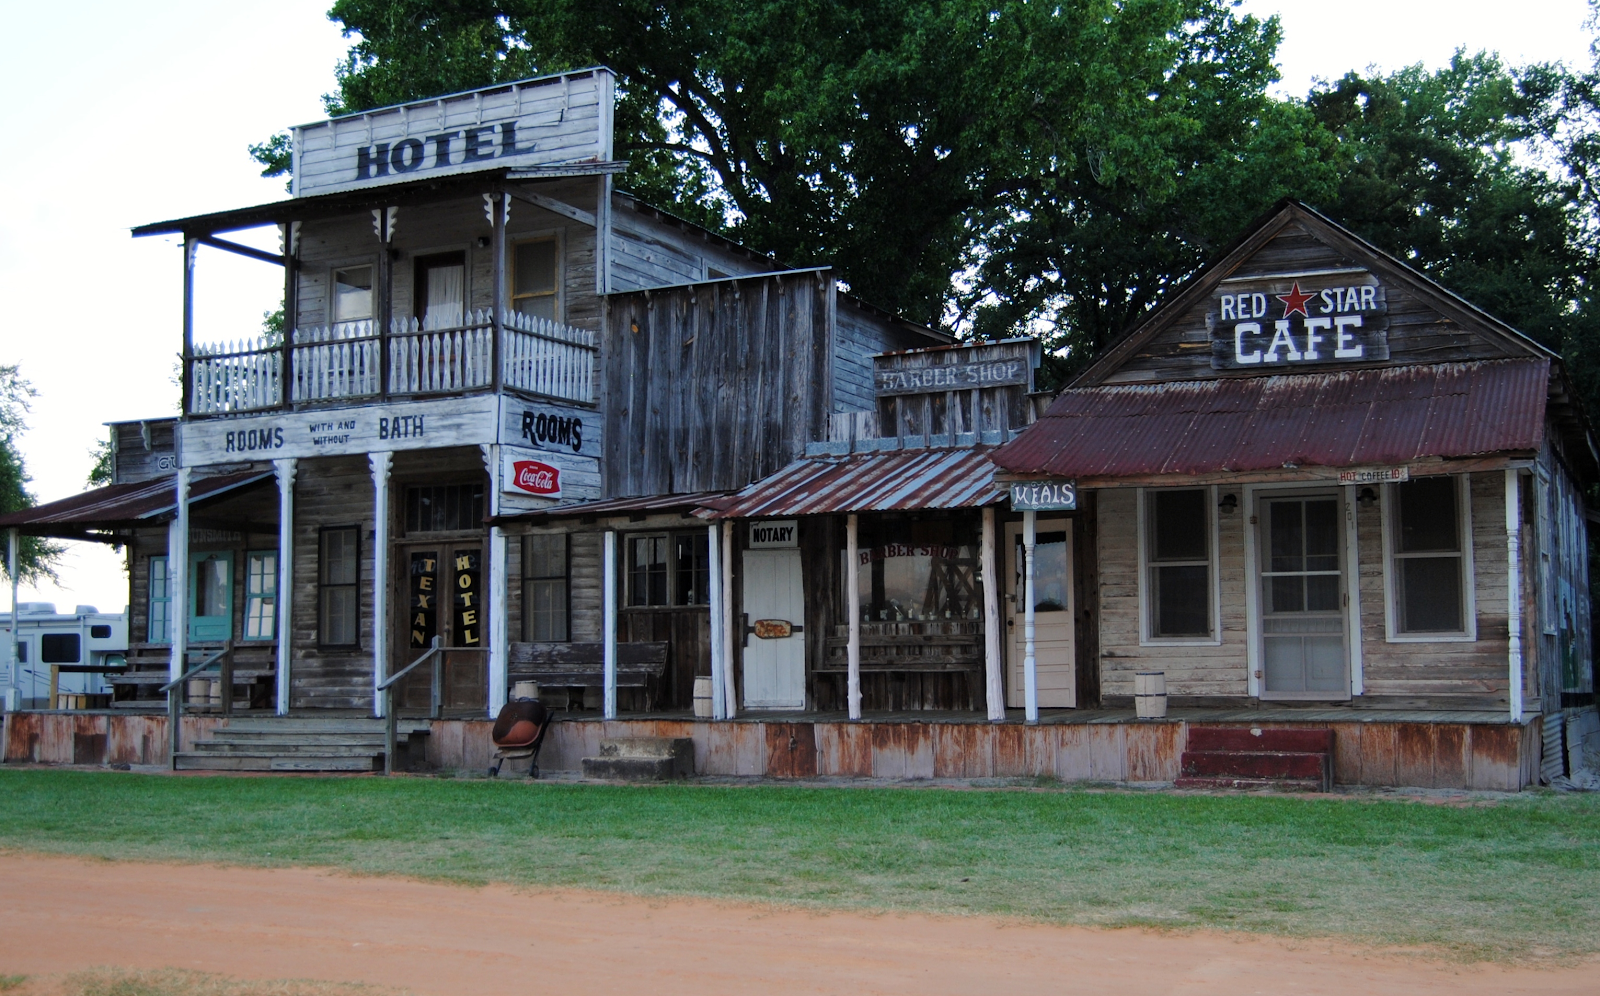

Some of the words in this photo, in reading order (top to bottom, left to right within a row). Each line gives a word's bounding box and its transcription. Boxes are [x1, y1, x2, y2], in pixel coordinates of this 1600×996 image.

[355, 121, 537, 181] HOTEL
[1221, 293, 1266, 320] RED
[1320, 286, 1376, 313] STAR
[1235, 315, 1362, 364] CAFE
[882, 367, 957, 390] BARBER
[967, 362, 1018, 383] SHOP
[309, 423, 333, 433] WITH
[337, 420, 355, 430] AND
[379, 415, 424, 439] BATH
[522, 411, 582, 452] ROOMS
[226, 427, 284, 452] ROOMS
[313, 434, 349, 445] WITHOUT
[520, 468, 553, 489] Coca-Cola
[1340, 472, 1356, 481] HOT
[1362, 471, 1389, 481] COFFEE
[1014, 483, 1074, 505] MEALS
[753, 527, 793, 543] NOTARY
[859, 544, 915, 566] BARBER
[920, 544, 958, 560] SHOP
[411, 558, 436, 645] TEXAN
[456, 555, 479, 644] HOTEL
